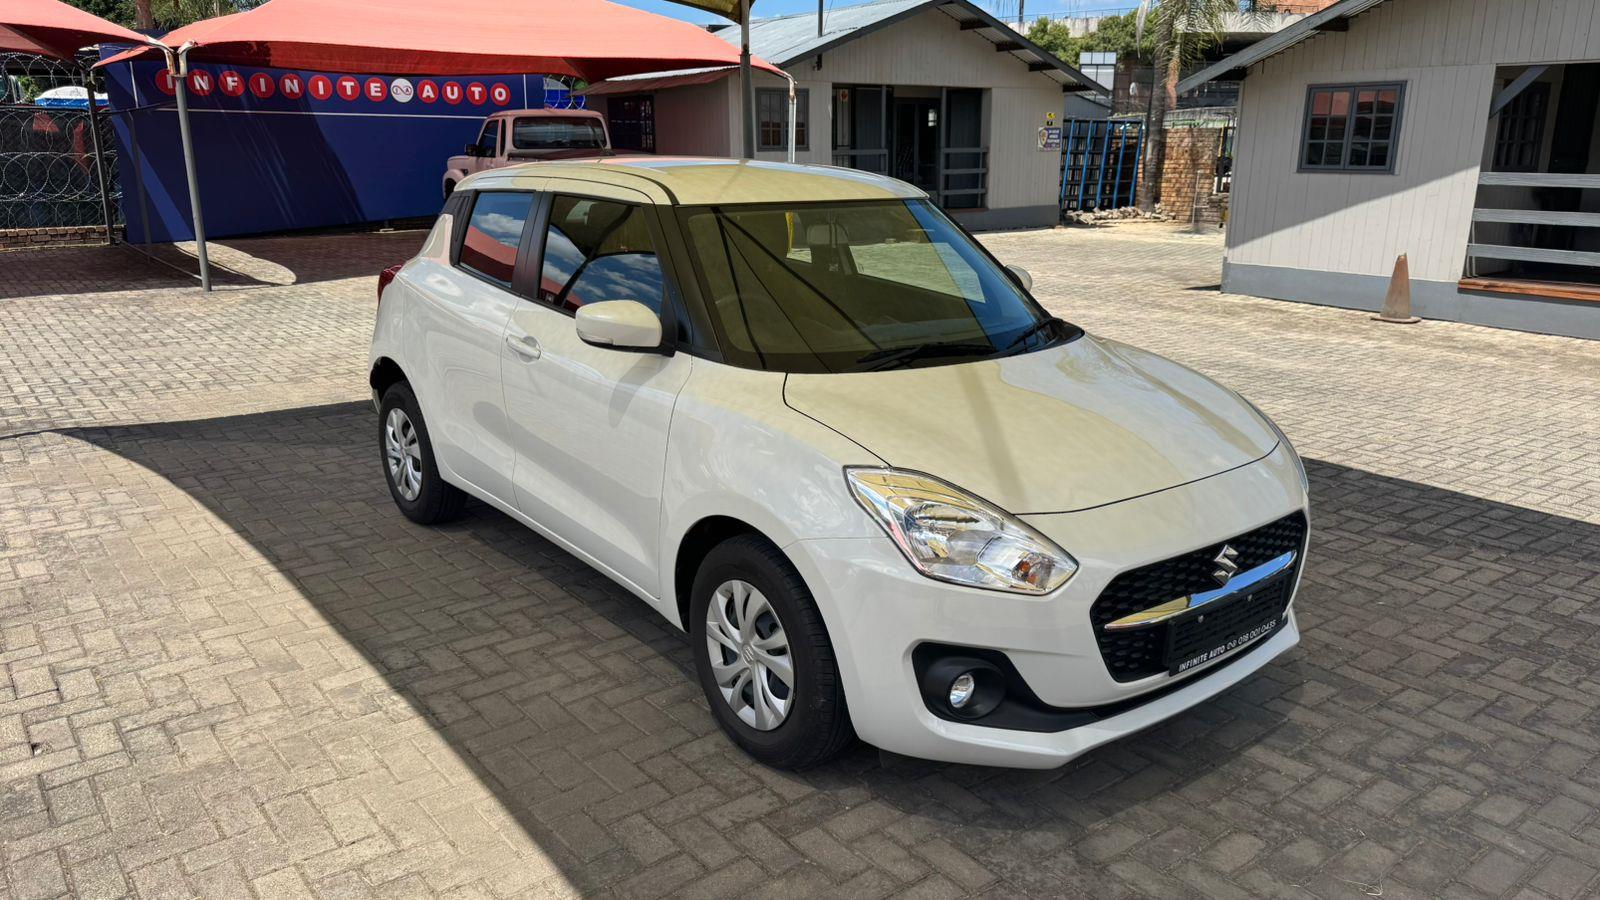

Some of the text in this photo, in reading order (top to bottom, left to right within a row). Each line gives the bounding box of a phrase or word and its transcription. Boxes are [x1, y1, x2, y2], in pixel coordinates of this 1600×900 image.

[166, 73, 382, 97] INFINITE
[421, 85, 507, 101] AUTO
[1178, 653, 1208, 672] INFINITE
[1208, 645, 1225, 660] AUTO
